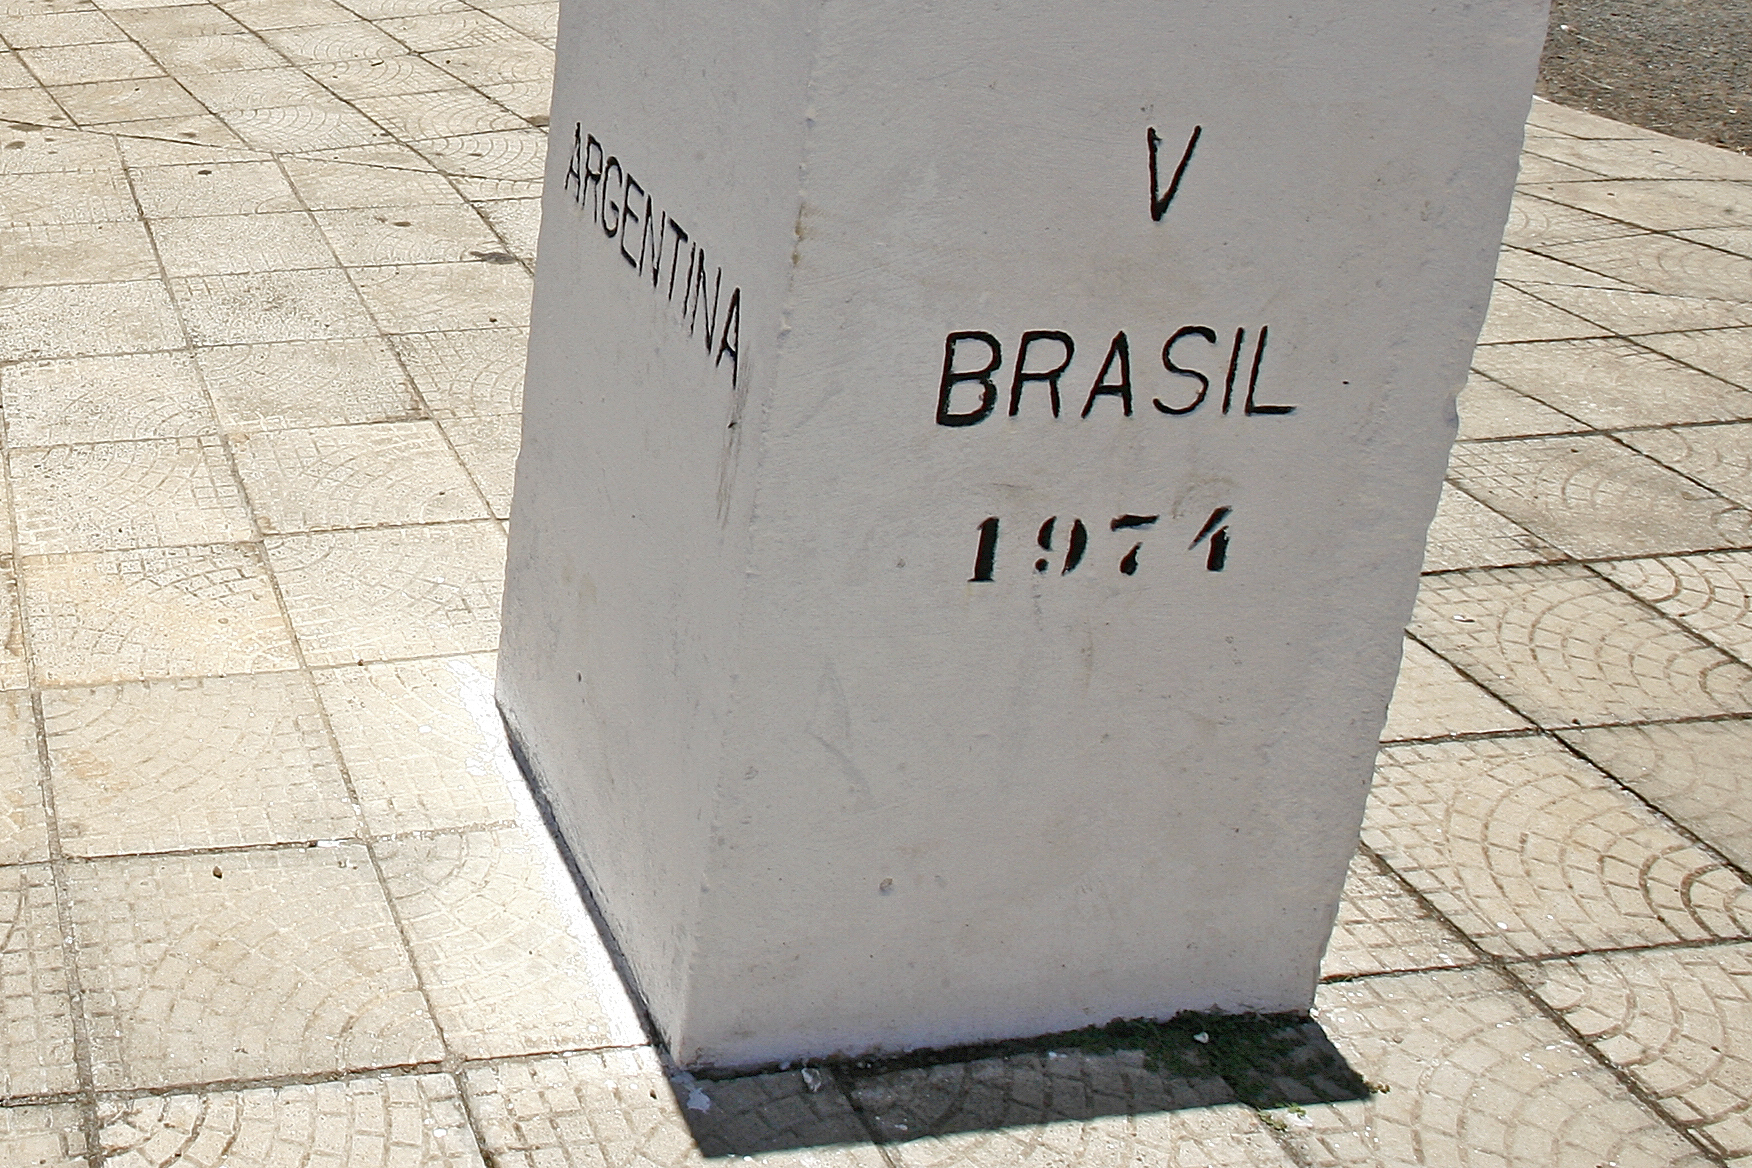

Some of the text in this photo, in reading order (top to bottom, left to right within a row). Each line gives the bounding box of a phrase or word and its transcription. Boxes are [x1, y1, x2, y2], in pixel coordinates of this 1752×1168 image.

[1147, 125, 1203, 222] V
[564, 121, 741, 391] ARGENTINA
[936, 325, 1298, 427] BRASIL
